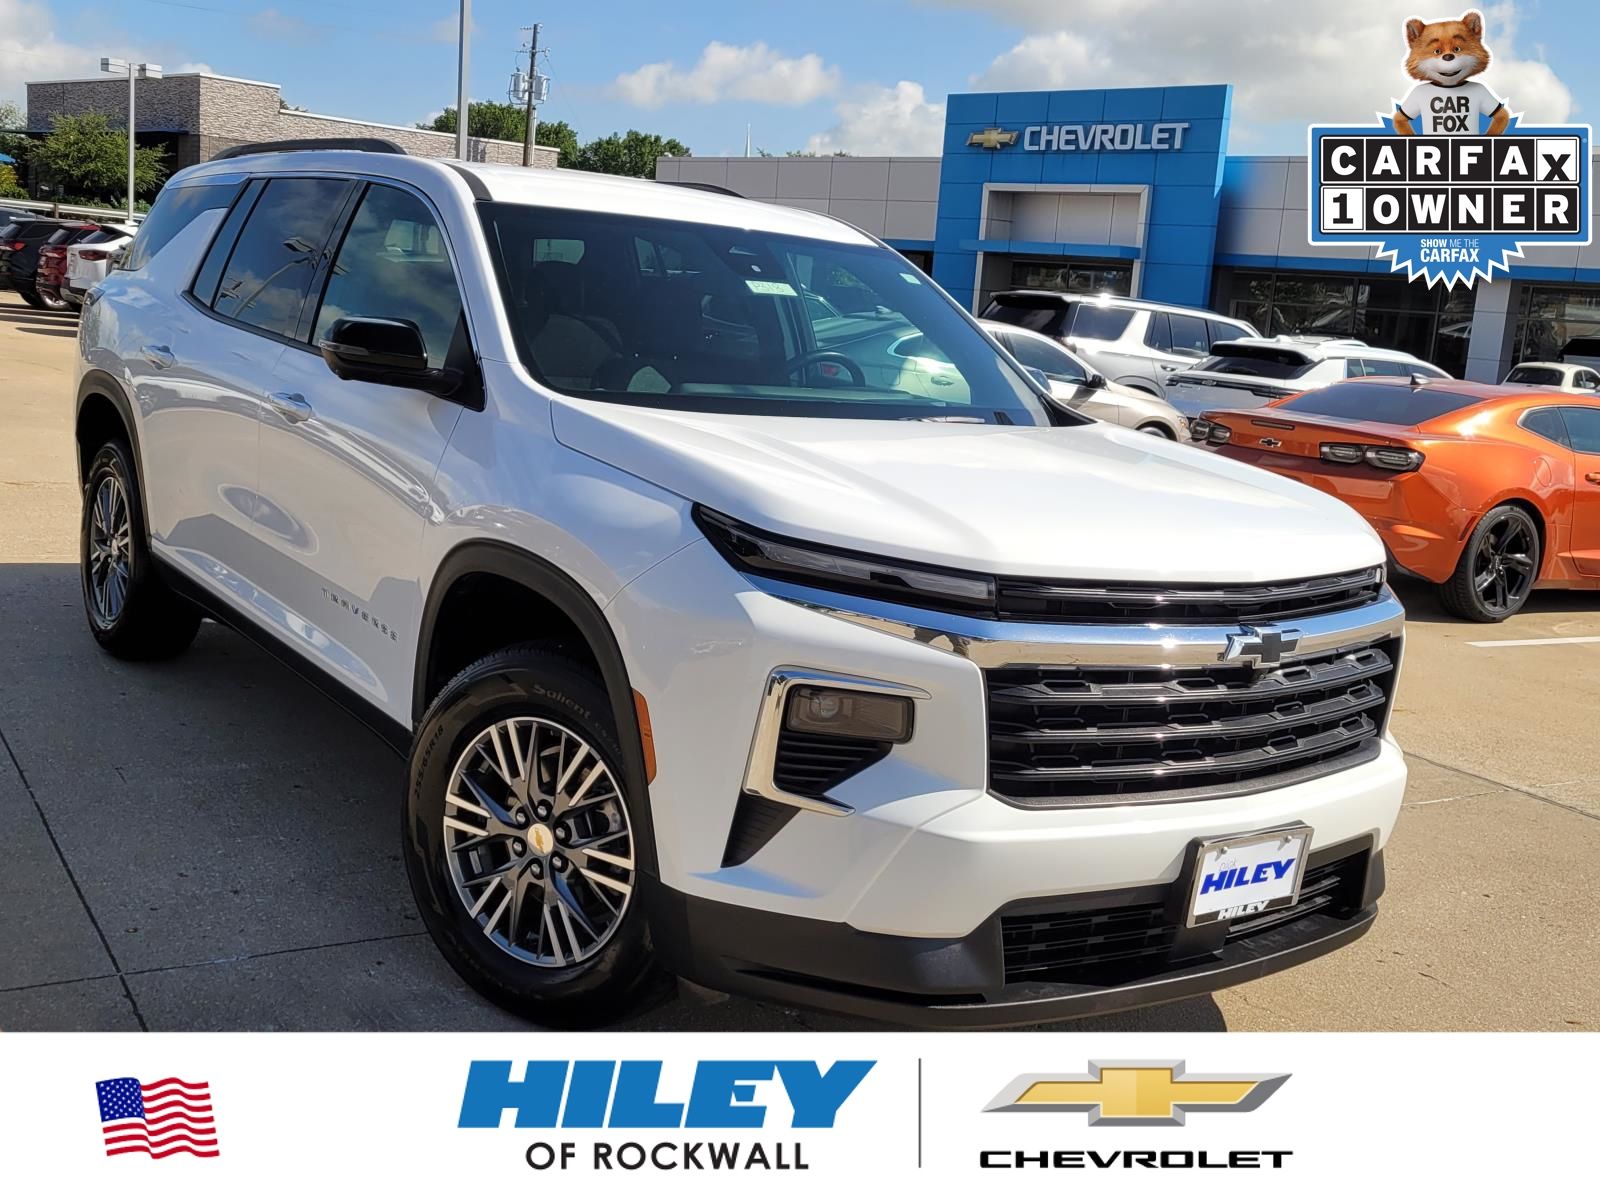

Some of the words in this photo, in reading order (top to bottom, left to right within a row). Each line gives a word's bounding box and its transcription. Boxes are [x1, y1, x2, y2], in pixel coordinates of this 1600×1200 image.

[1024, 122, 1191, 151] CHEVROLET
[321, 587, 398, 641] TRAVERSE
[1200, 858, 1296, 895] HILEY
[1217, 900, 1270, 920] HILEY
